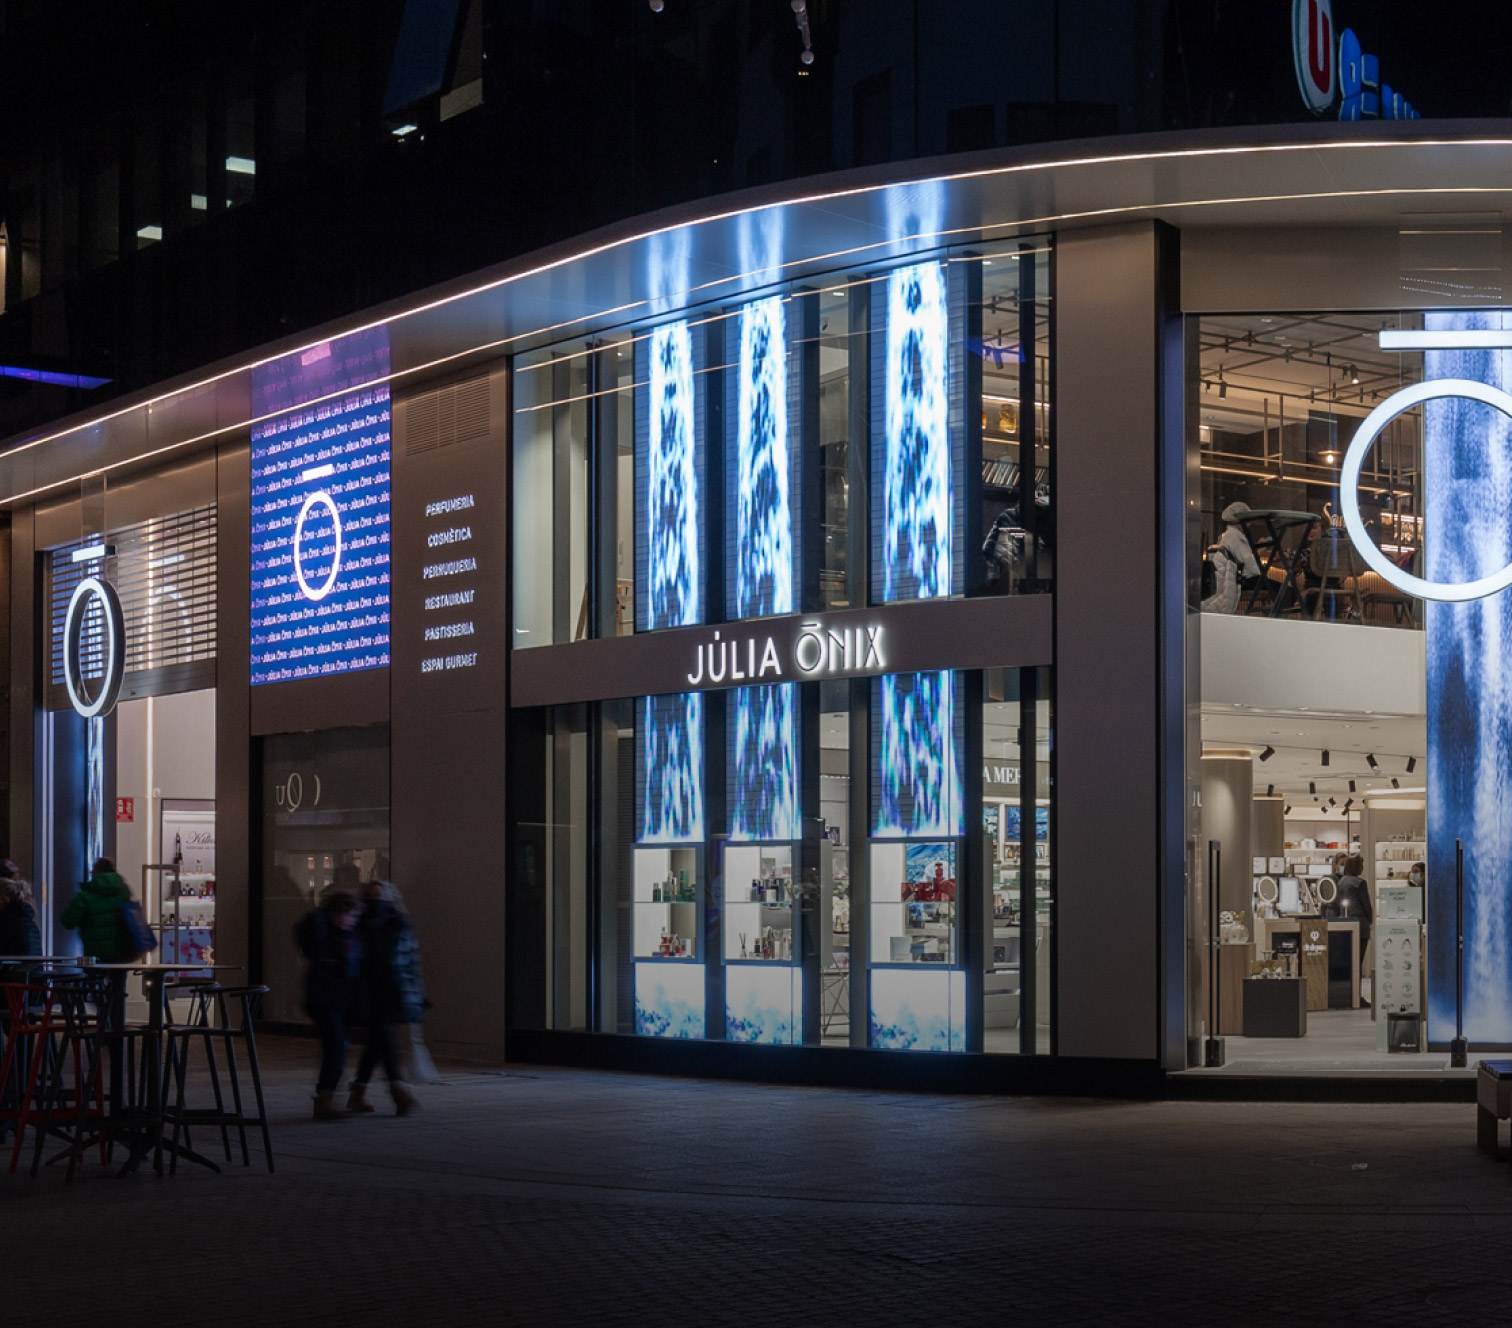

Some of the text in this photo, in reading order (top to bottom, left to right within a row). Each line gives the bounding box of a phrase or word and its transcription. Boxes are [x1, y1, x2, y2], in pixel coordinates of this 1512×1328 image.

[425, 495, 474, 517] PERFUMERIA
[428, 526, 472, 547] COSMÈTICA
[423, 557, 477, 579] PERRUQUERIA
[425, 590, 475, 610] RESTAURANT
[425, 621, 474, 641] PASTISSERIA
[421, 658, 444, 673] ESPAI
